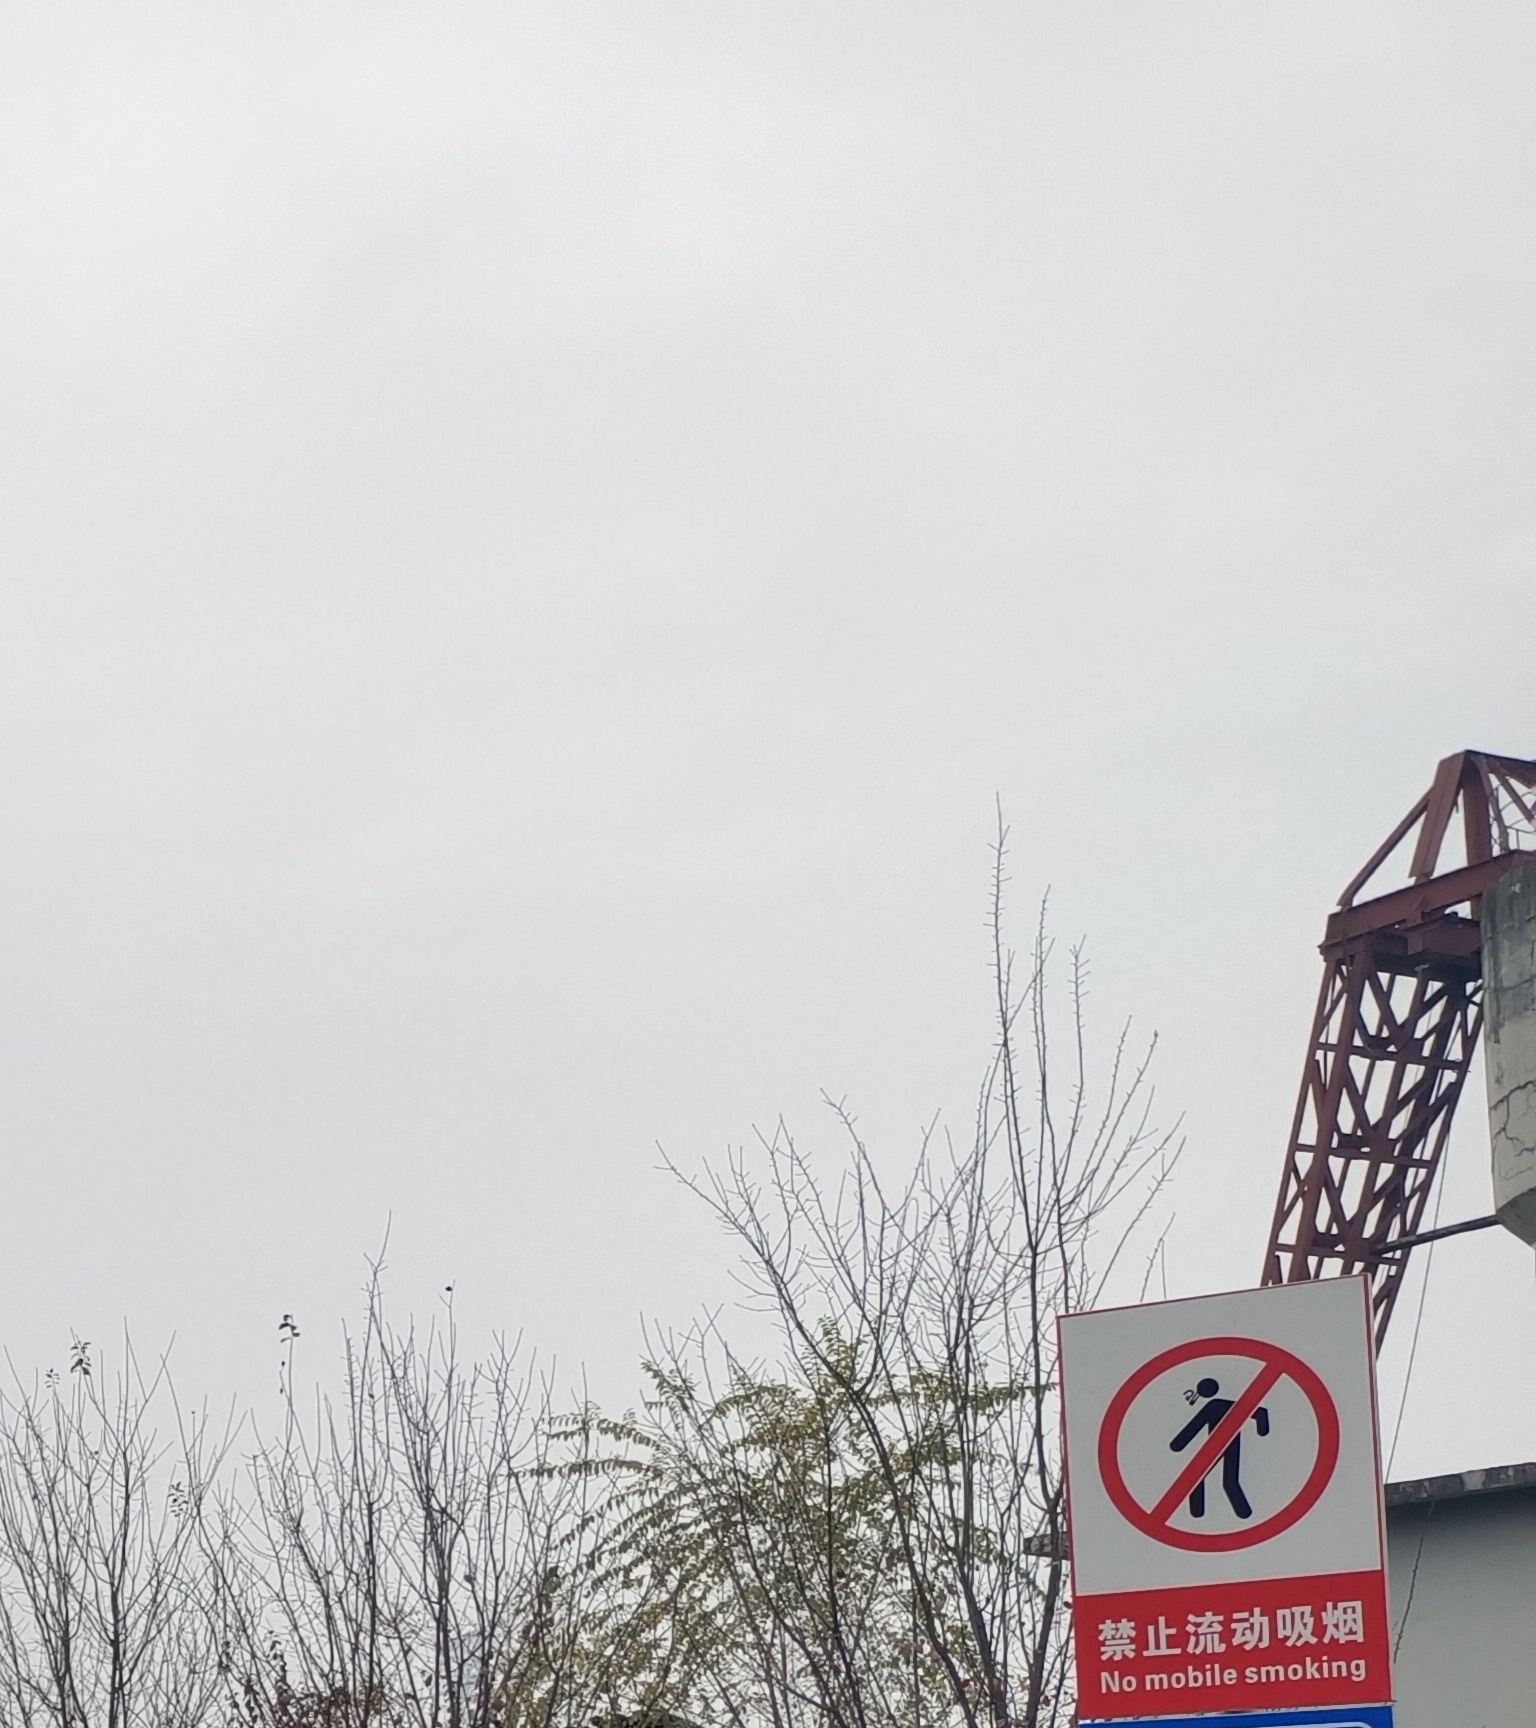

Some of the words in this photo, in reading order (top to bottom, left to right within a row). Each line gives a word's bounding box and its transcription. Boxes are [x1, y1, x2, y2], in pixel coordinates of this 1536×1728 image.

[1098, 1600, 1364, 1661] 禁止流动吸烟
[1100, 1671, 1137, 1693] No
[1145, 1664, 1237, 1690] mobile
[1244, 1655, 1366, 1684] smoking
